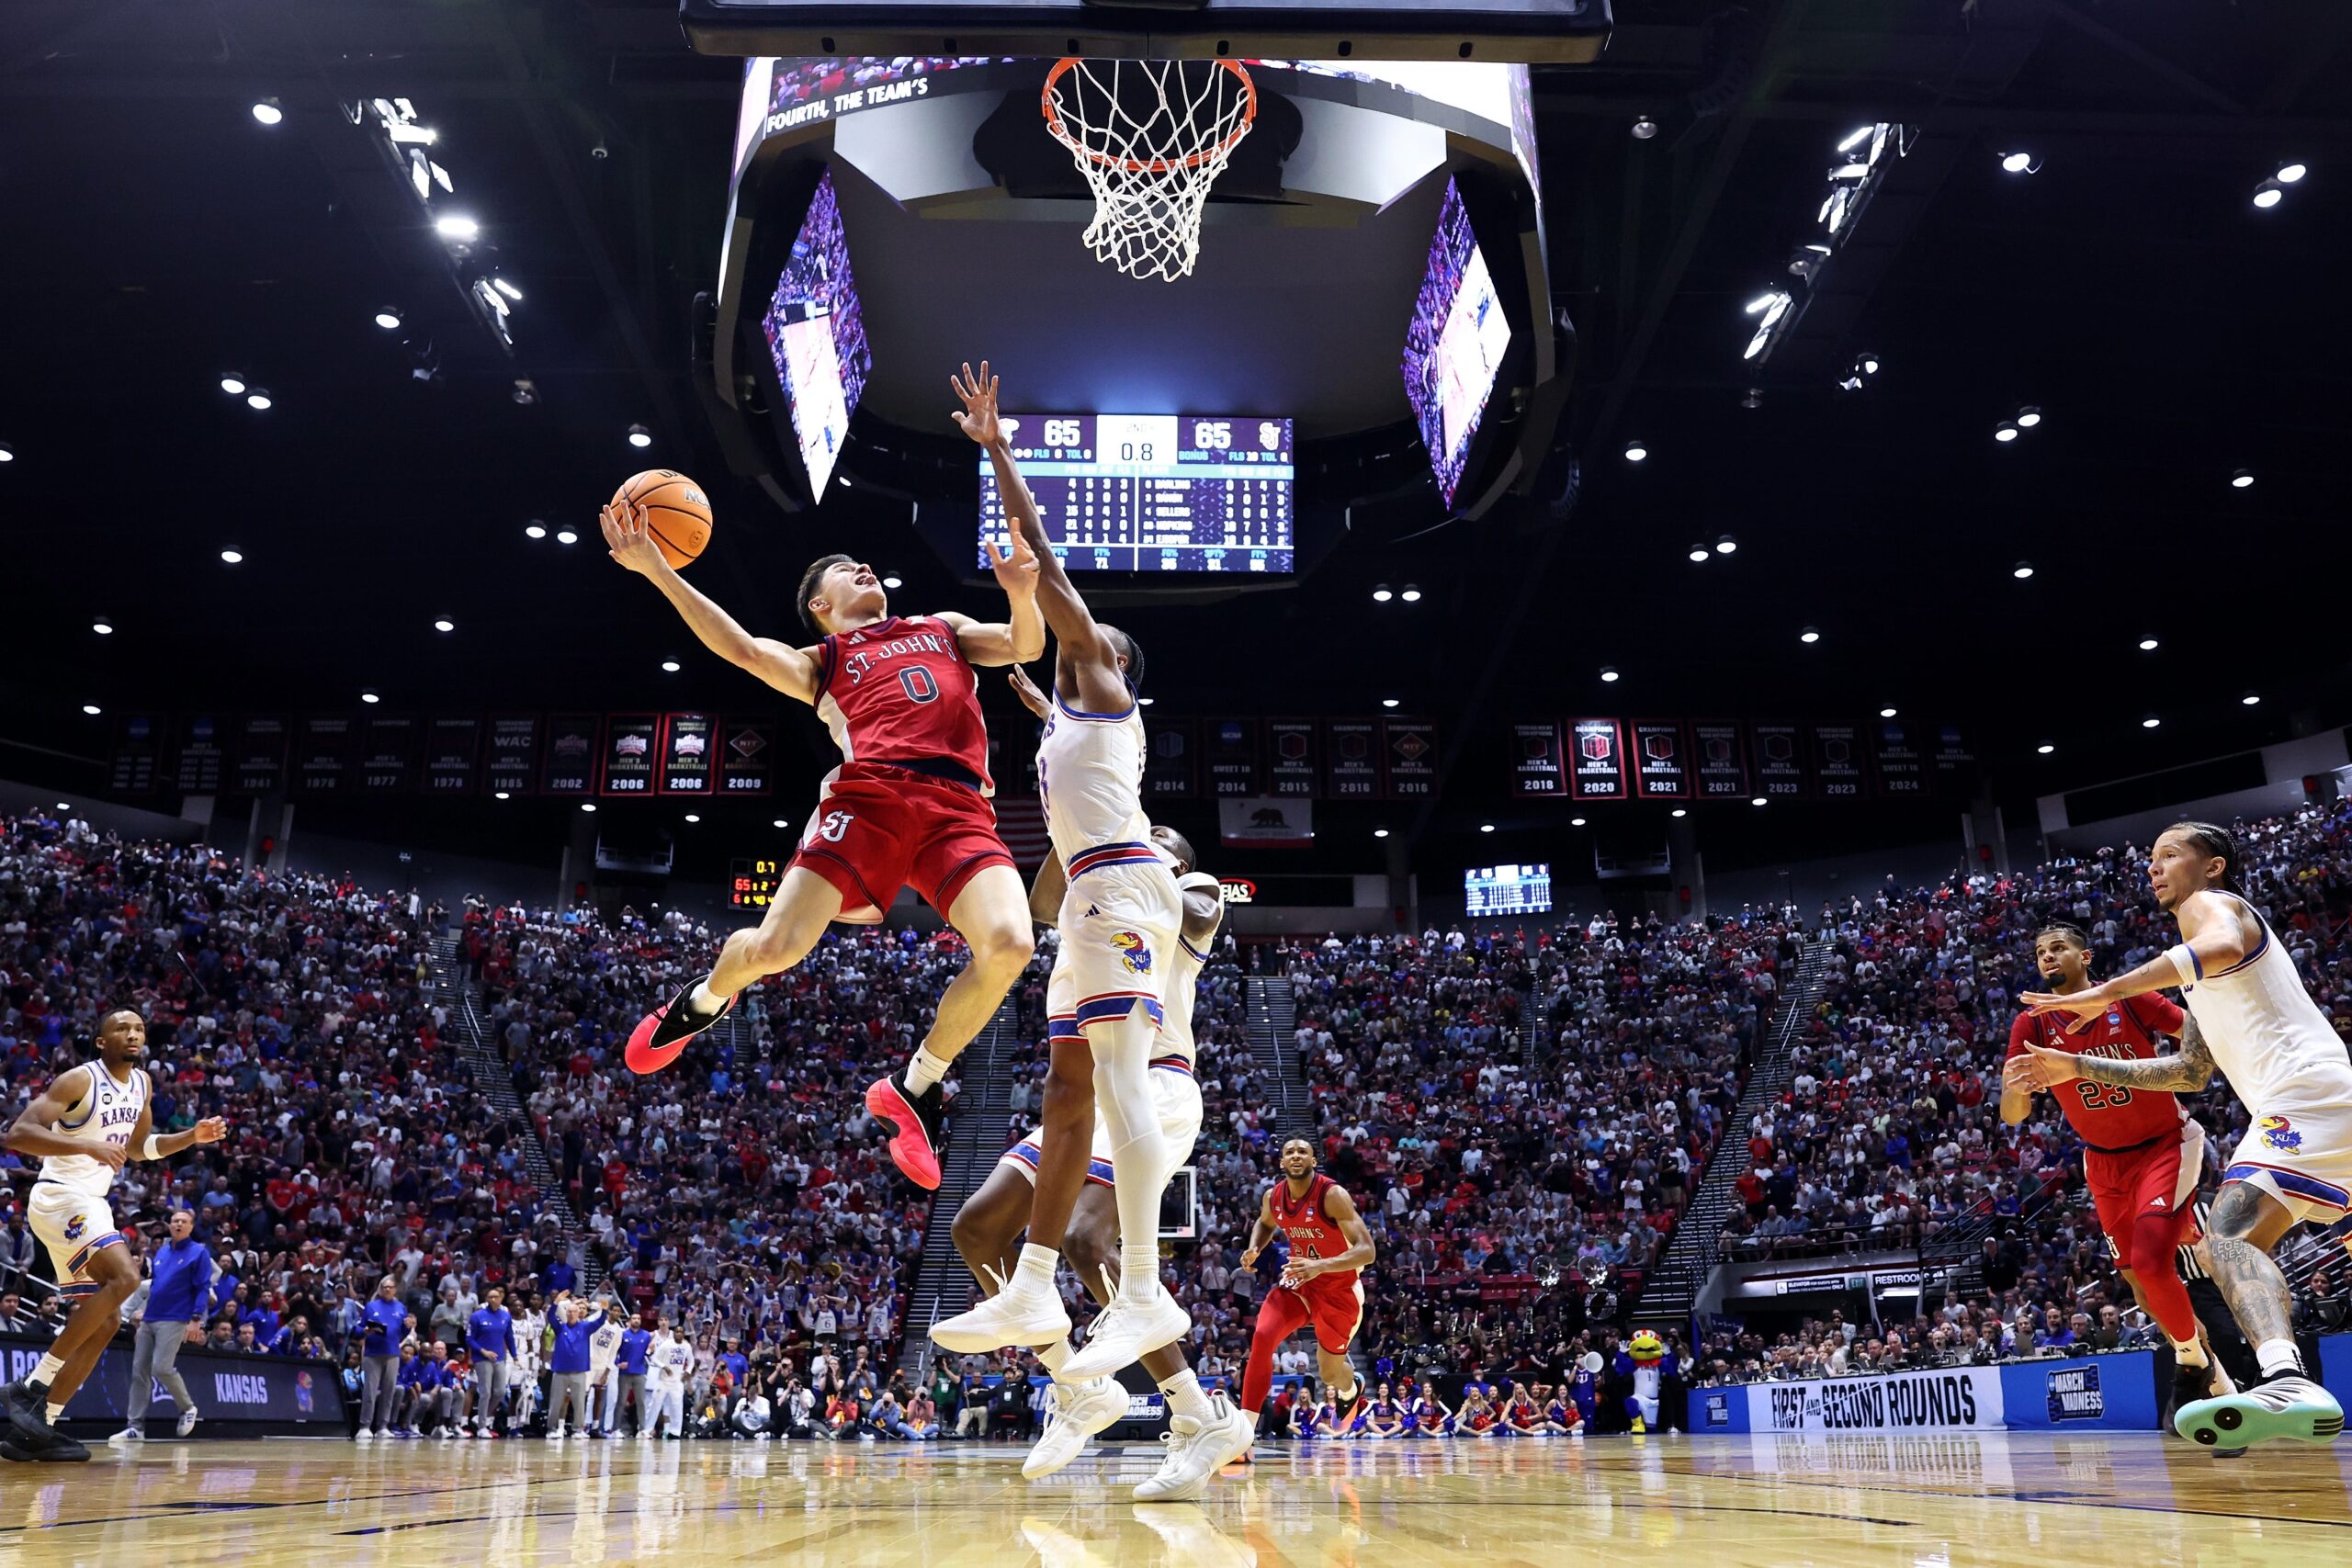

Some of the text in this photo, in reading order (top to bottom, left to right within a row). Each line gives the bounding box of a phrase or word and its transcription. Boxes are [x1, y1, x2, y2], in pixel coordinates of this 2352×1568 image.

[766, 77, 928, 133] FOURTH, THE TEAM'S
[1045, 420, 1080, 446] 65
[1195, 423, 1231, 448] 65
[1122, 443, 1153, 461] 0.8
[1179, 450, 1209, 460] BONUS
[1243, 479, 1250, 491] 1
[1260, 493, 1267, 505] 1
[1120, 505, 1127, 516] 1
[1243, 521, 1251, 532] 7
[1260, 521, 1267, 532] 1
[1095, 558, 1109, 570] 71
[845, 634, 957, 684] ST. JOHN'S
[899, 665, 939, 704] 0
[493, 736, 532, 747] WAC
[1213, 765, 1238, 773] SWEET
[1642, 766, 1682, 774] BASKETBALL
[367, 775, 397, 786] 1977
[552, 778, 582, 789] 2002
[611, 779, 645, 790] 2006
[671, 778, 703, 789] 2006
[728, 778, 762, 789] 2009
[1154, 781, 1185, 791] 2014
[1524, 779, 1555, 790] 2018
[1889, 781, 1918, 791] 2024
[1217, 782, 1247, 792] 2014
[1279, 782, 1309, 793] 2015
[1340, 783, 1371, 793] 2016
[1398, 783, 1429, 793] 2016
[1583, 782, 1615, 794] 2020
[1649, 782, 1678, 793] 2021
[1708, 783, 1736, 793] 2021
[1769, 783, 1798, 794] 2023
[1827, 784, 1857, 795] 2023
[819, 810, 854, 843] SJ
[756, 861, 775, 874] 0.7
[735, 878, 751, 891] 65
[1220, 884, 1249, 901] EJAS
[733, 895, 741, 904] 6
[1135, 954, 1146, 964] KU
[2076, 1080, 2132, 1111] 23
[2276, 1134, 2290, 1142] KU
[1289, 1226, 1324, 1238] JOHN'S
[1851, 1279, 1863, 1288] EXIT
[2055, 1372, 2084, 1393] MARCH
[215, 1373, 267, 1404] KANSAS
[1129, 1396, 1148, 1405] RCH
[1771, 1375, 1976, 1428] FIRST AND SECOND ROUNDS
[2061, 1391, 2103, 1411] MADNESS
[1125, 1406, 1162, 1416] ADNESS
